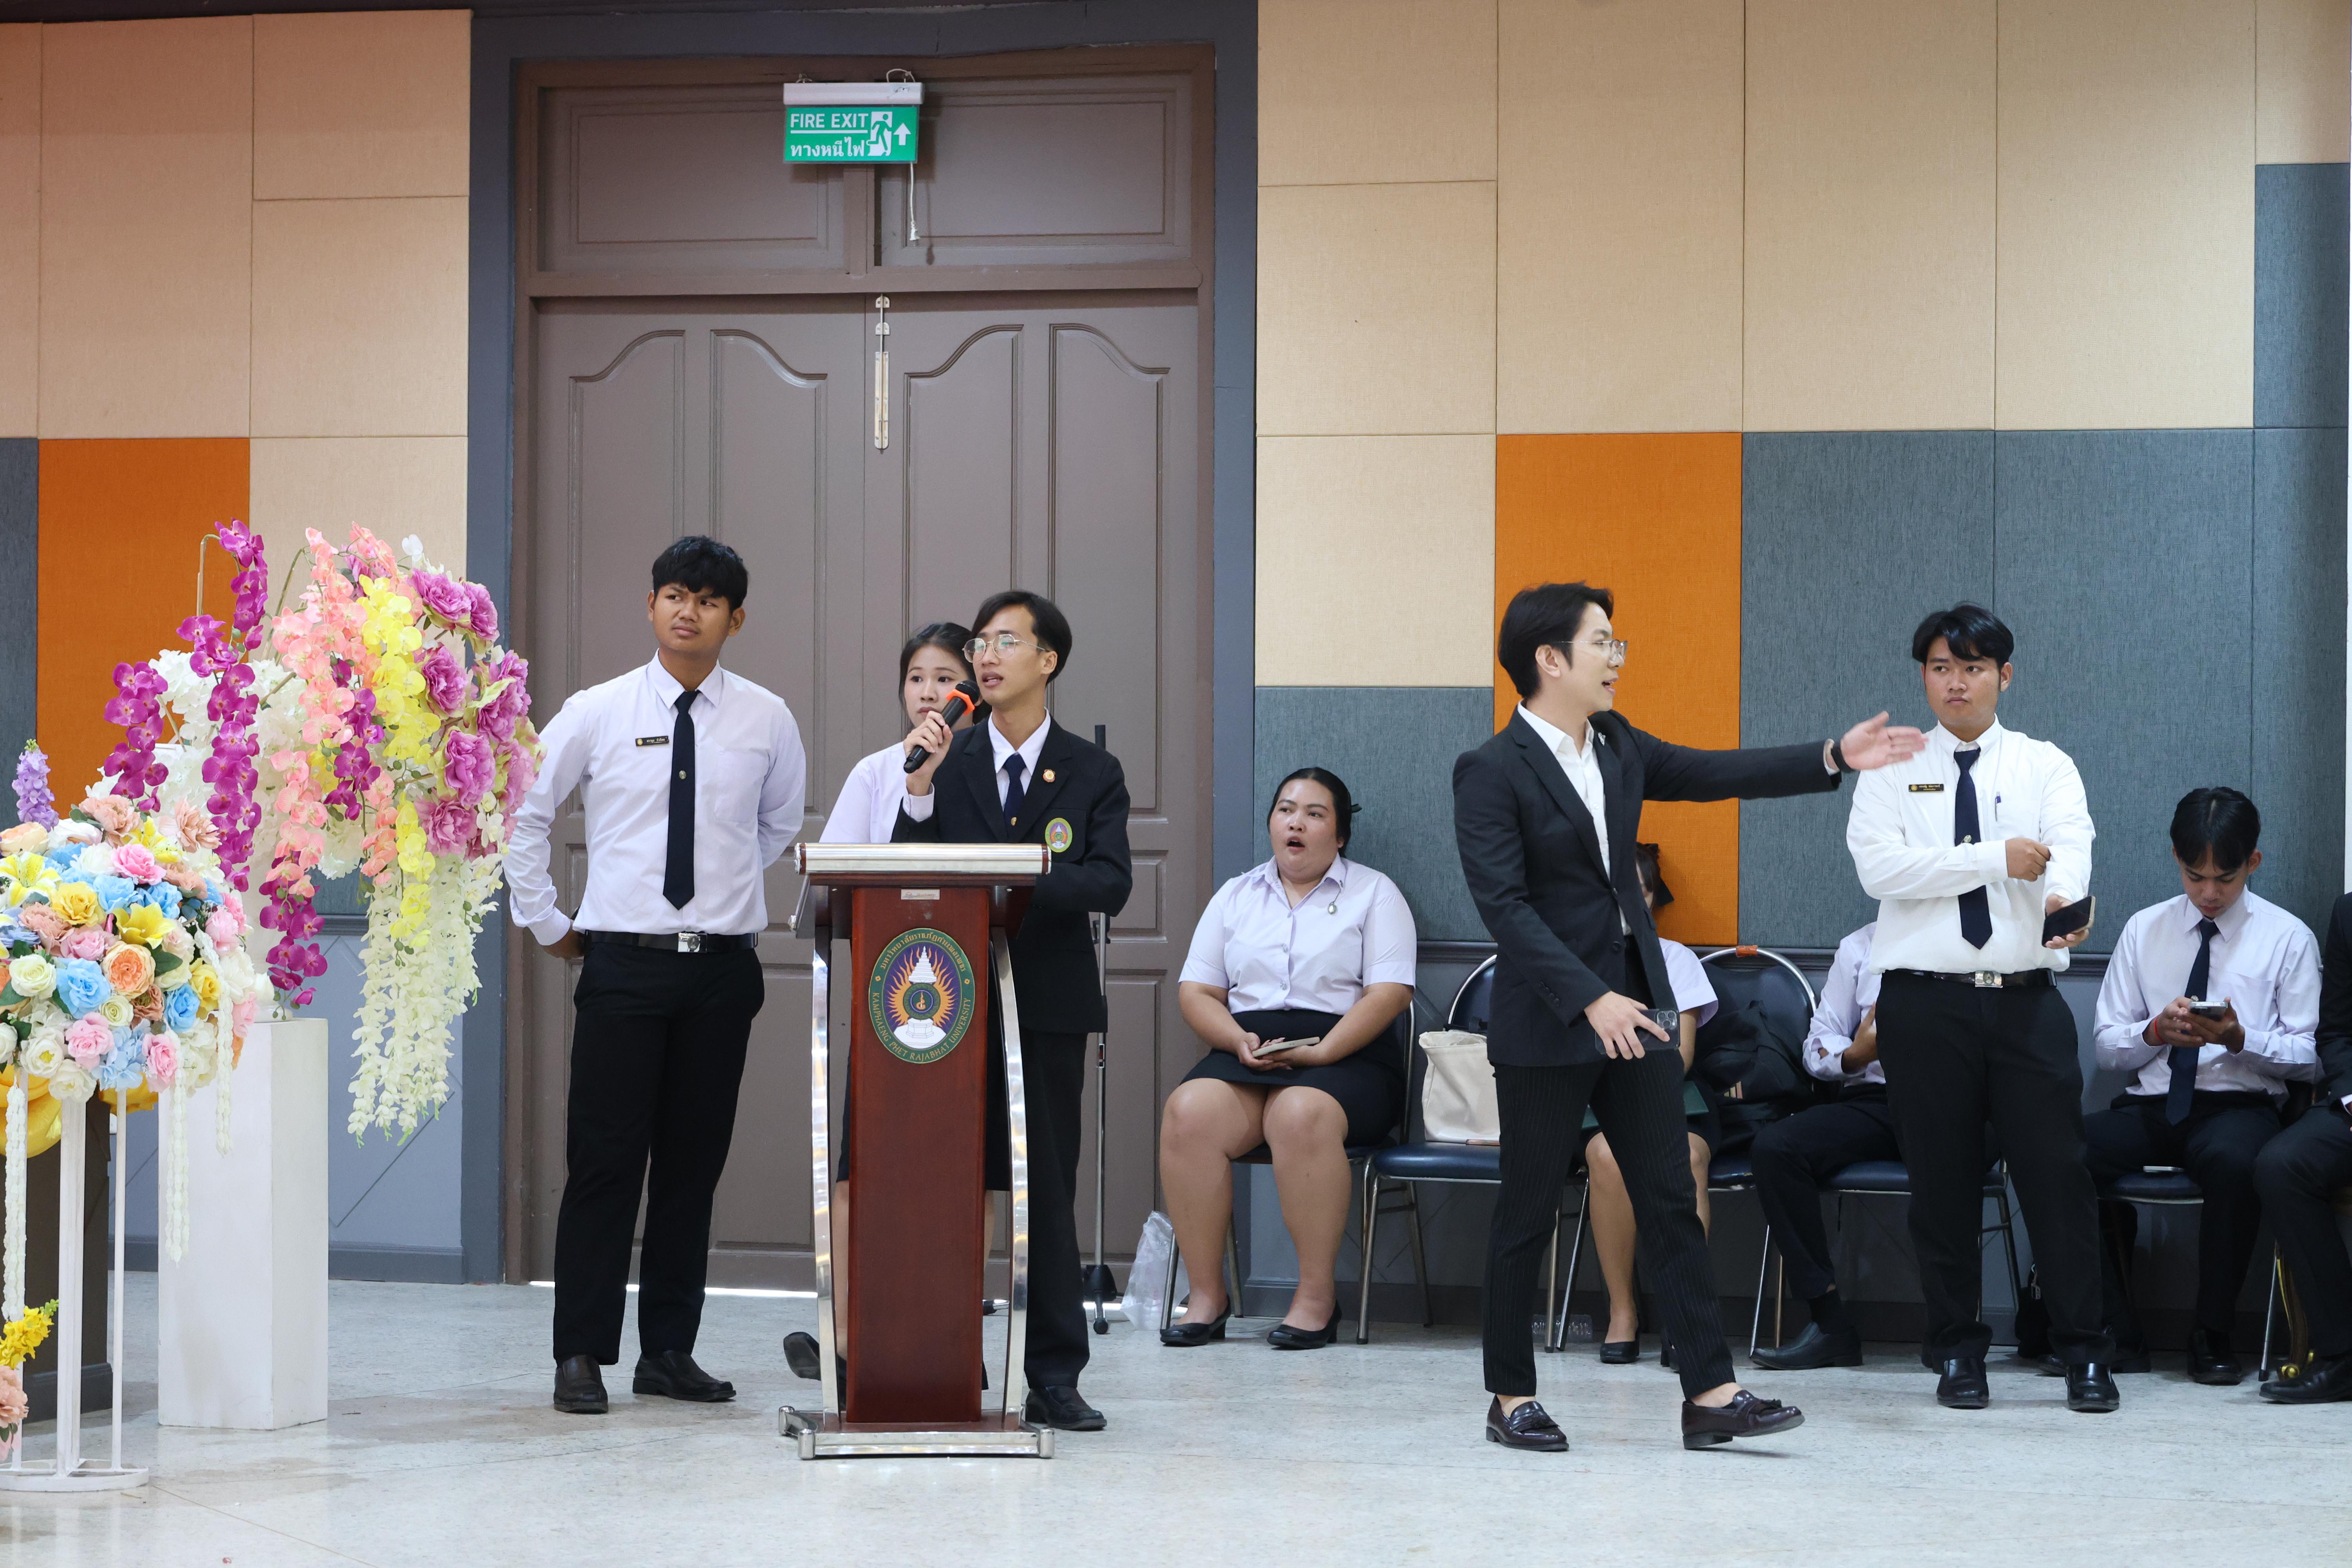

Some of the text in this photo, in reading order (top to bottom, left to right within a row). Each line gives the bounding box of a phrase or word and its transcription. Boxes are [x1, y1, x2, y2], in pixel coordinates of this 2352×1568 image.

[790, 113, 869, 128] FIRE EXIT
[791, 136, 865, 157] ทางหนีไฟ
[872, 992, 971, 1062] KAMPHAENG PHET RAJABHAT UNIVERSITY
